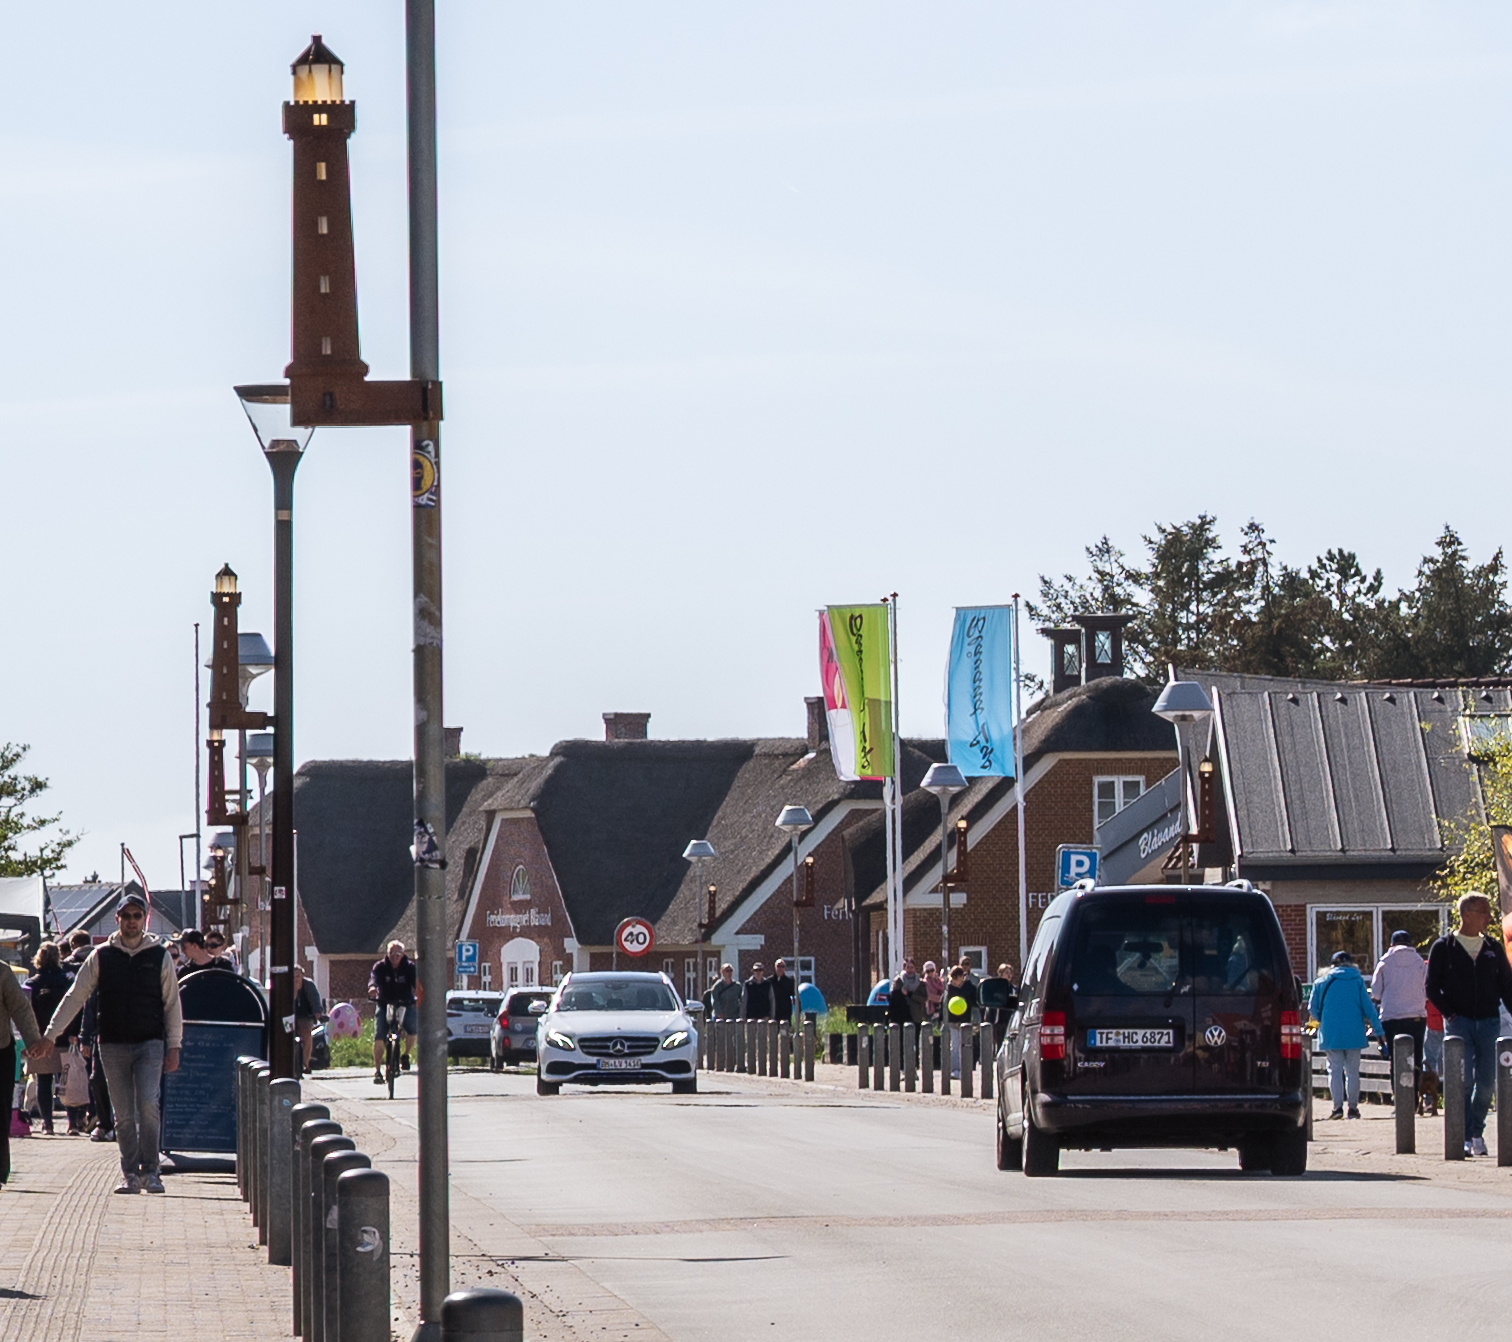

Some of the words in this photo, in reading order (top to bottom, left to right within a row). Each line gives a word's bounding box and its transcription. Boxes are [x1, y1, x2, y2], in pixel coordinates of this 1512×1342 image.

[1070, 854, 1091, 877] P
[824, 905, 852, 920] Feri
[624, 931, 647, 945] 40
[462, 945, 474, 957] P
[1097, 1031, 1113, 1044] TF
[1122, 1031, 1138, 1044] HC
[1141, 1031, 1172, 1044] 6871
